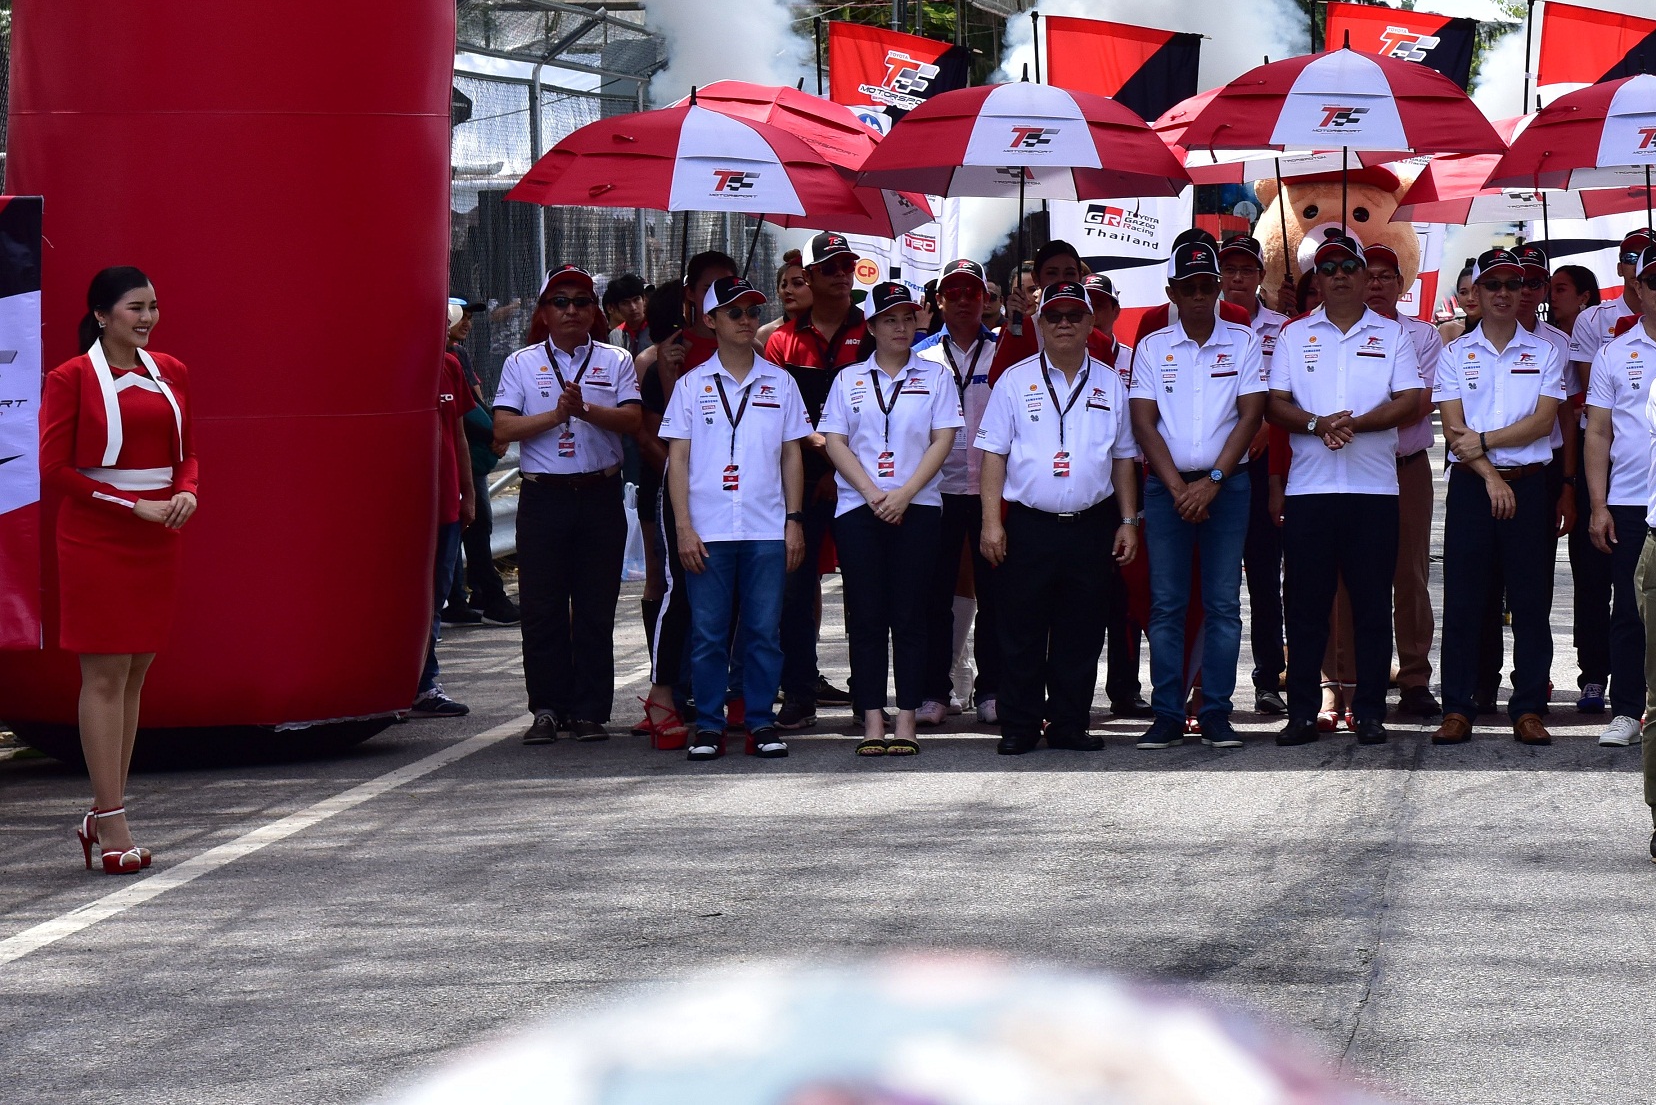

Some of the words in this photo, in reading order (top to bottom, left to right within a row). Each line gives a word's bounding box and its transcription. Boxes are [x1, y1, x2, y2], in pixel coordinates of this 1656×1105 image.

[860, 85, 924, 106] MOTORSPO
[1085, 210, 1122, 228] GR
[1124, 217, 1156, 230] GAZOO
[1126, 210, 1160, 225] TYOTA
[1122, 223, 1154, 237] Racing
[904, 235, 936, 253] TRD
[1084, 227, 1159, 250] Thailand
[857, 265, 877, 279] CP
